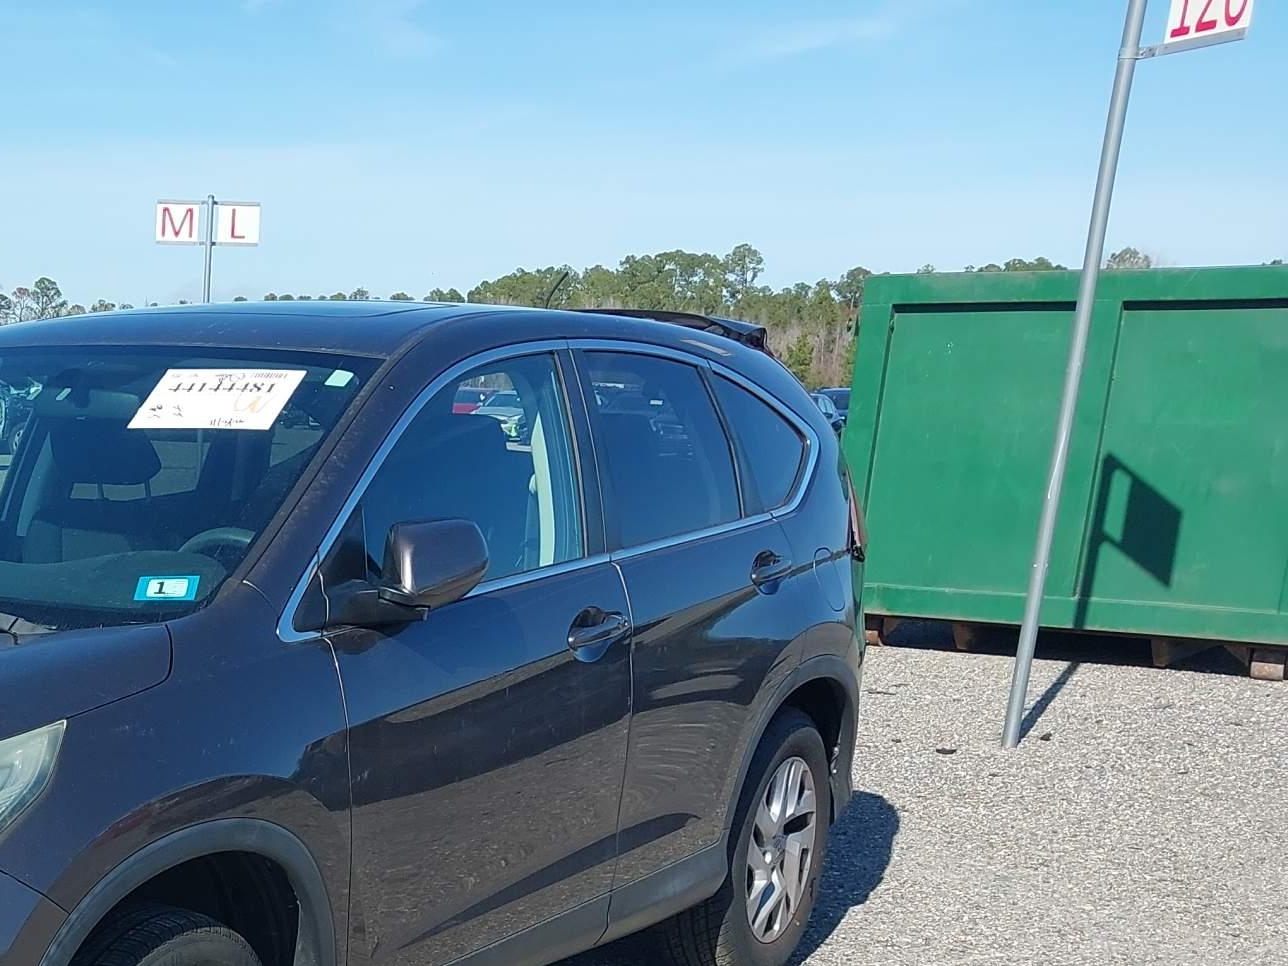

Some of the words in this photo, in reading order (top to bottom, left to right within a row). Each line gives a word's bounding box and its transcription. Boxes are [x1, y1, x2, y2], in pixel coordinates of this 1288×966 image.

[161, 206, 194, 238] M
[230, 208, 246, 239] L
[153, 581, 166, 595] 1
